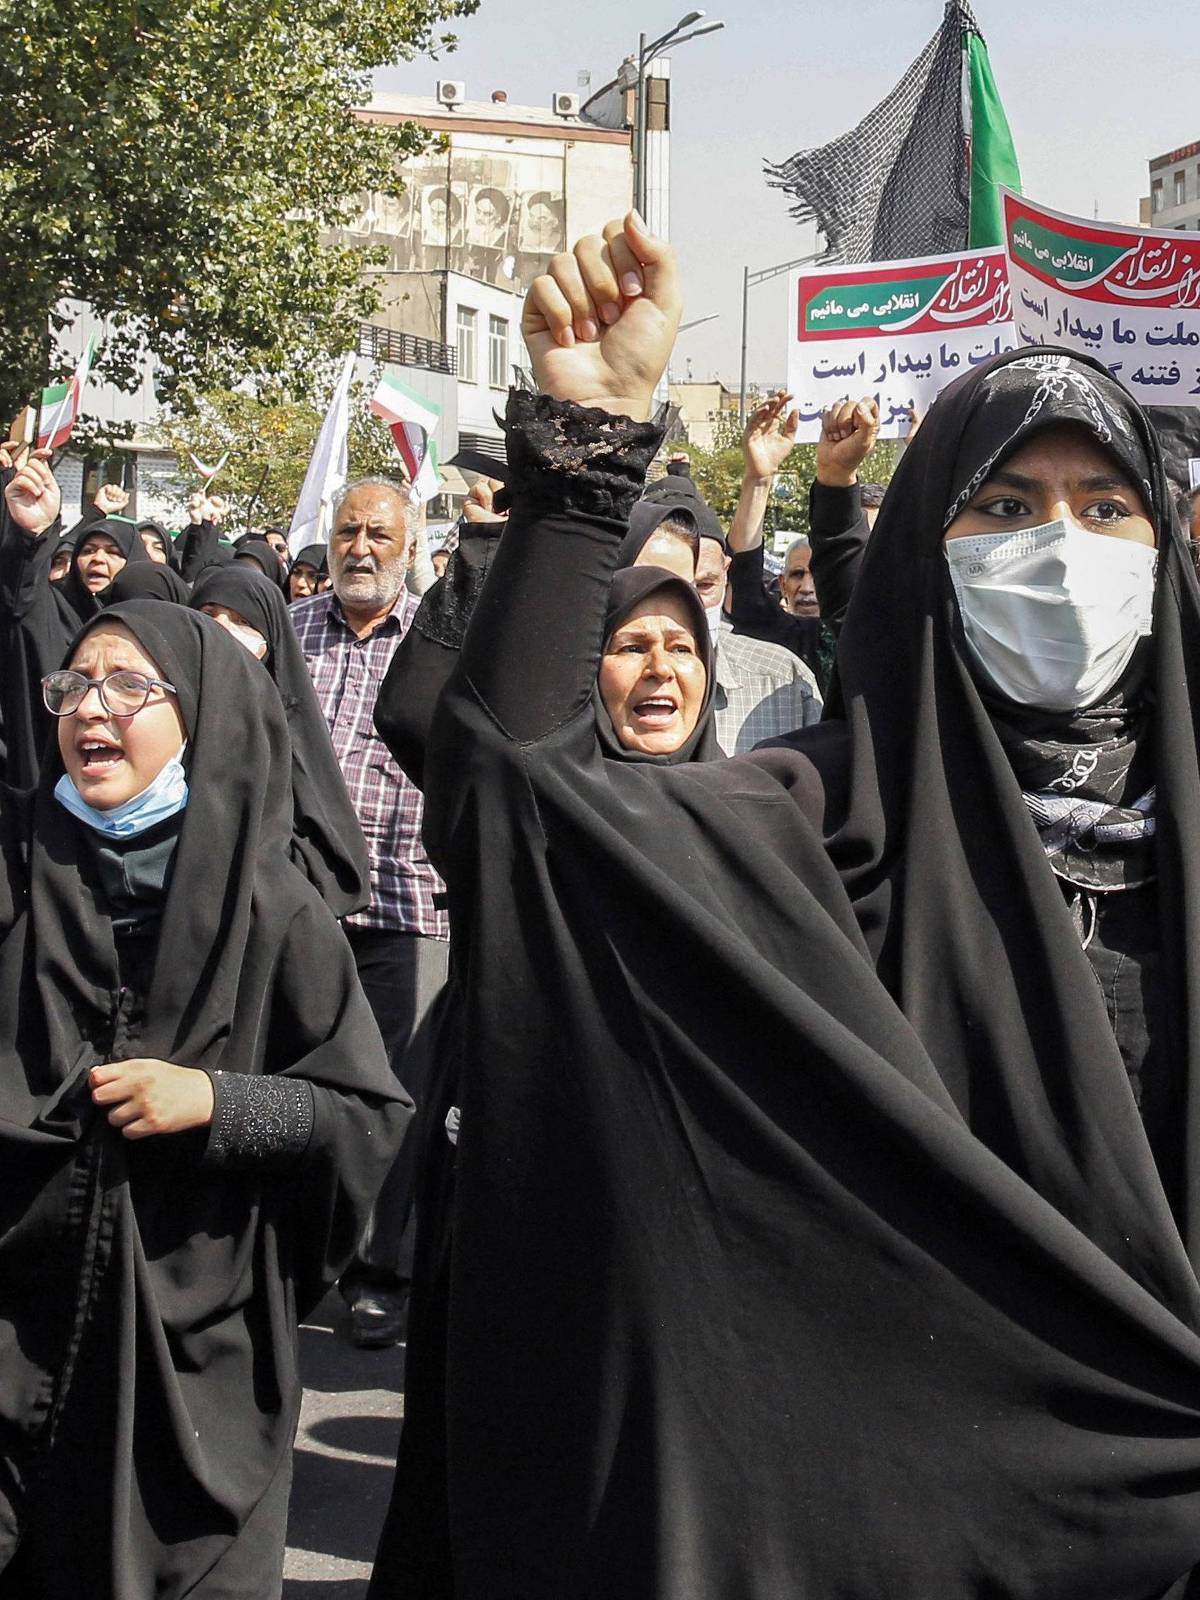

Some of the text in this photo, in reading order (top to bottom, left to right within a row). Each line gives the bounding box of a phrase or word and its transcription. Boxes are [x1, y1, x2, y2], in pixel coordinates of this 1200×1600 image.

[1013, 229, 1094, 273] انقلابی می مانیم
[810, 292, 920, 321] انقلابی می مانیم
[1020, 287, 1200, 349] ملت ما بیدار است
[812, 351, 865, 380] است
[873, 349, 933, 383] بیدار
[939, 343, 960, 369] ما
[1131, 361, 1181, 386] فتنه
